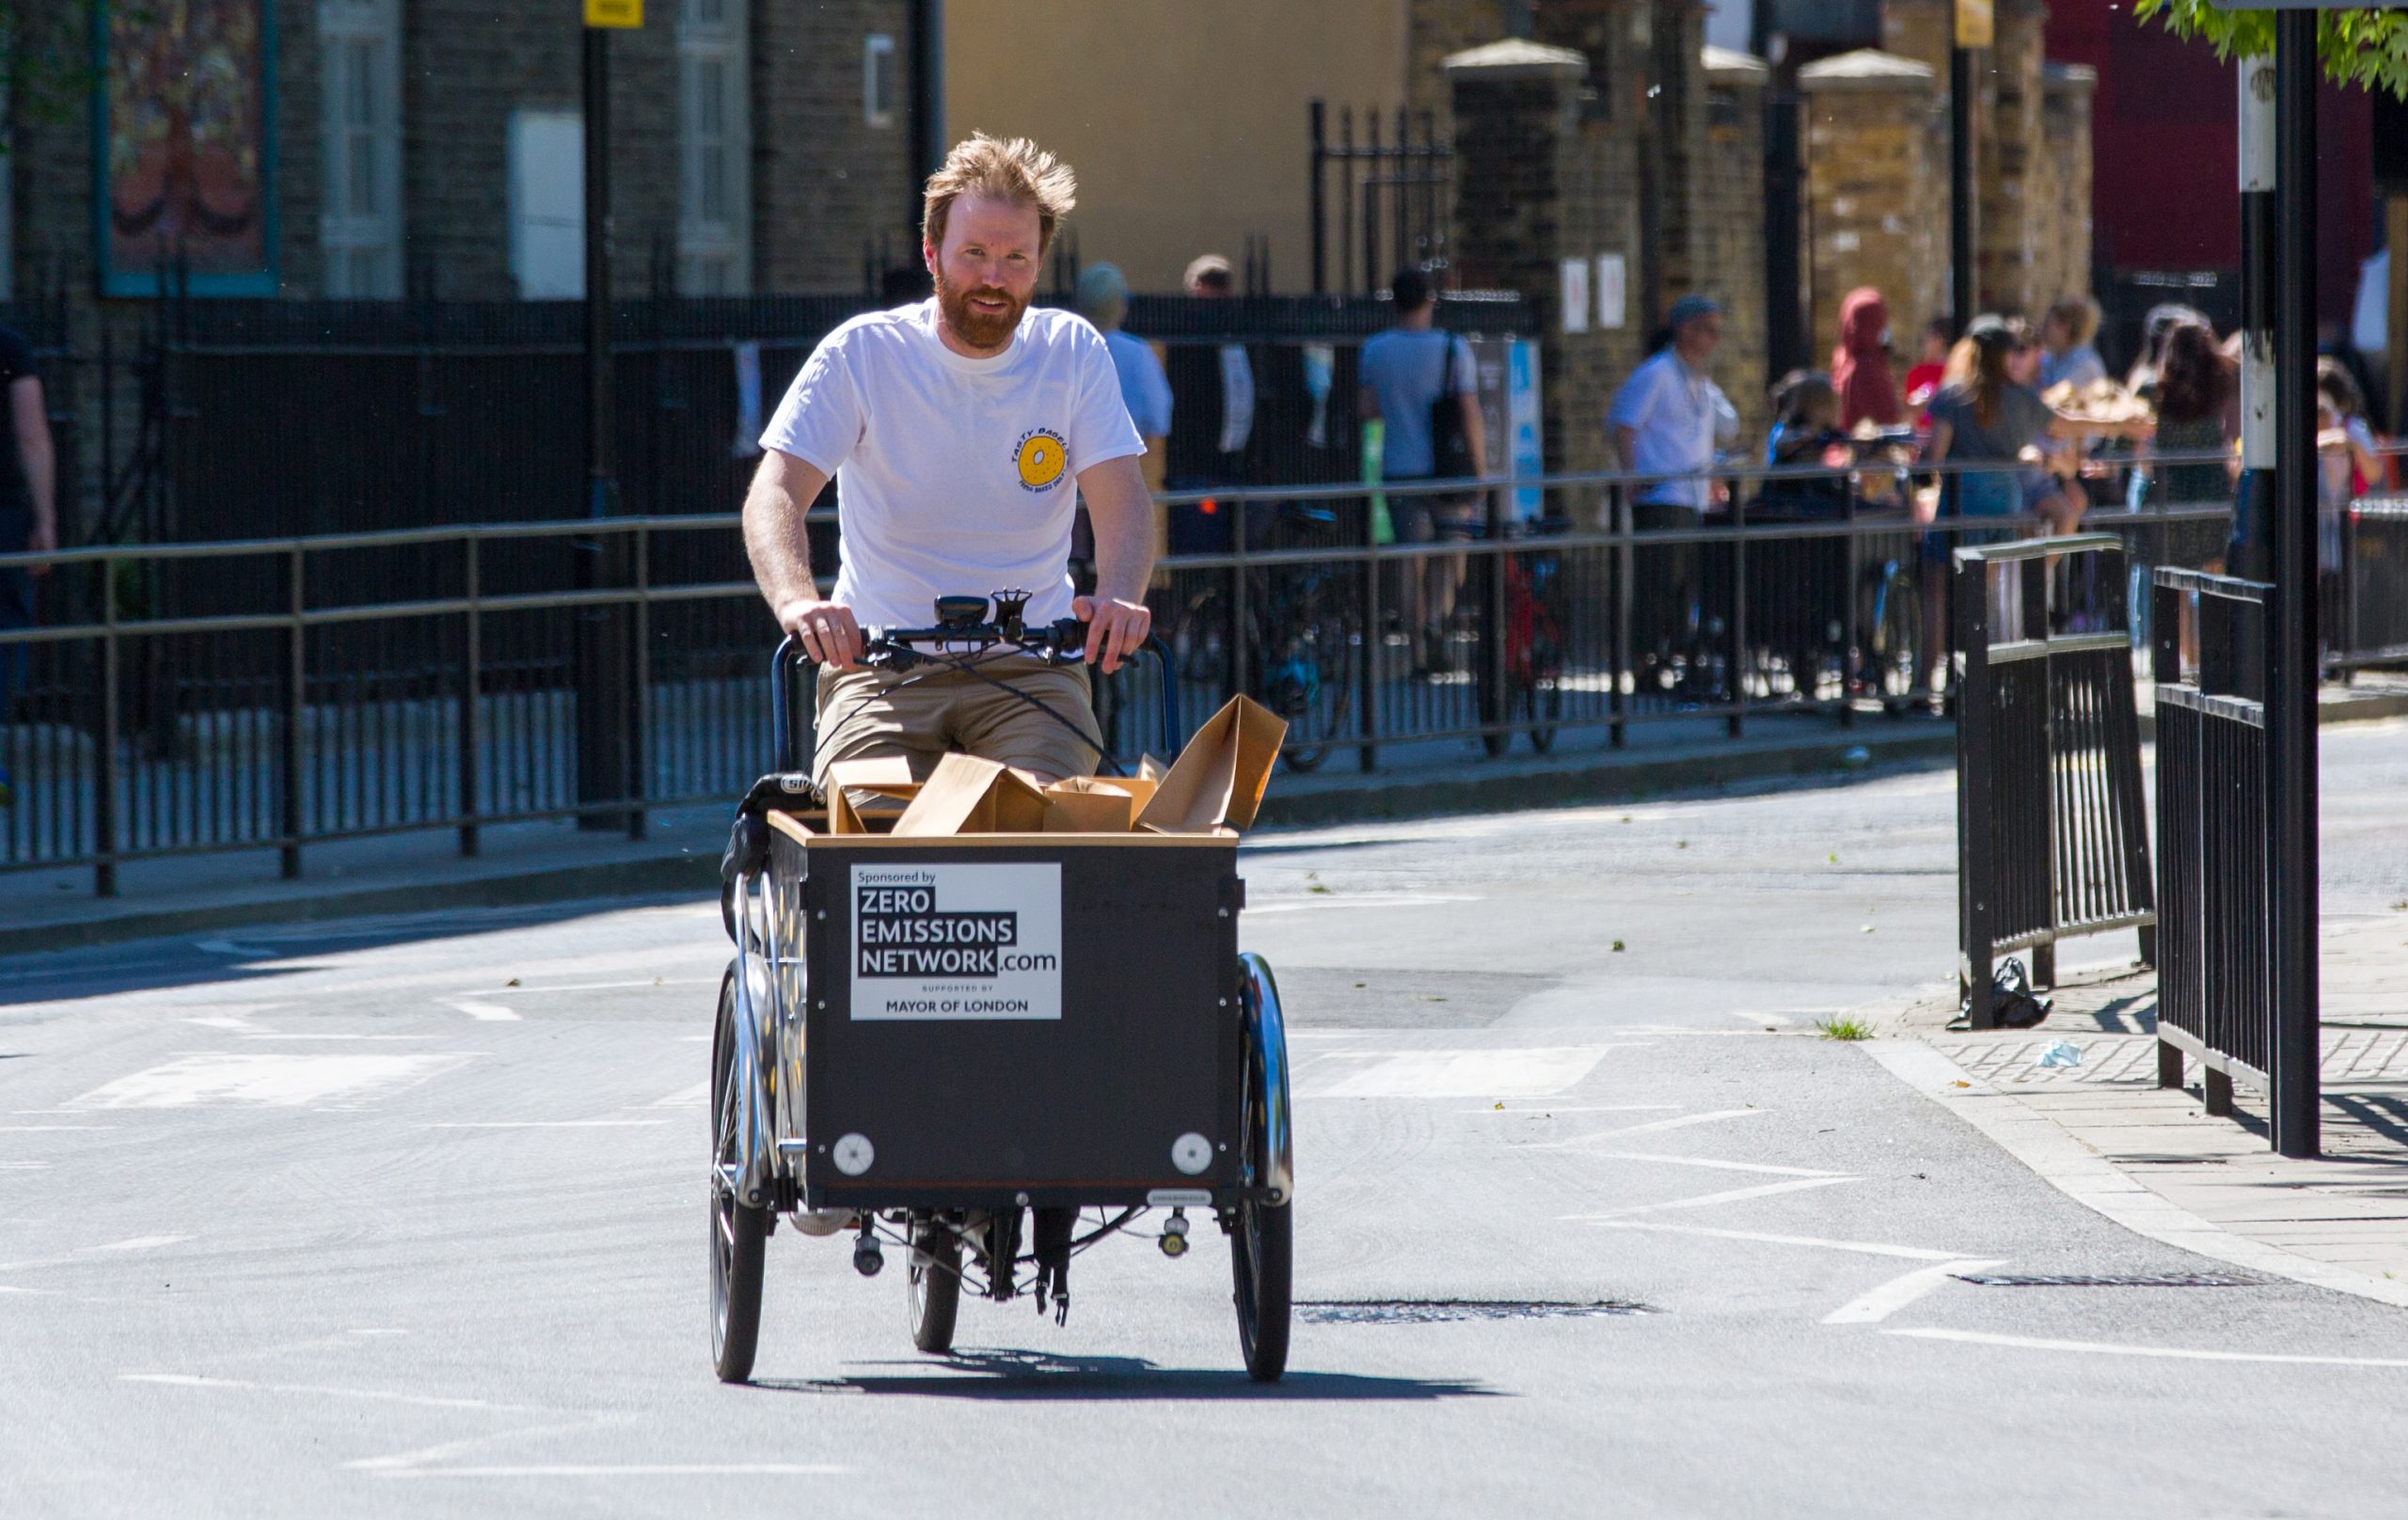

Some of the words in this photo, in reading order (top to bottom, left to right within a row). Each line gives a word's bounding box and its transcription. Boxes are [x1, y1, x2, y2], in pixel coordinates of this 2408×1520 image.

[1011, 429, 1034, 463] TASTY
[1038, 427, 1069, 456] BAGELS
[858, 871, 919, 884] Sponsored
[922, 871, 936, 885] by
[861, 889, 930, 913] ZERO
[862, 918, 1012, 943] EMISSIONS
[862, 948, 1056, 973] NETWORK.com
[886, 1000, 936, 1013] MAYOR
[941, 1000, 960, 1012] OF
[964, 1000, 1029, 1012] LONDON
